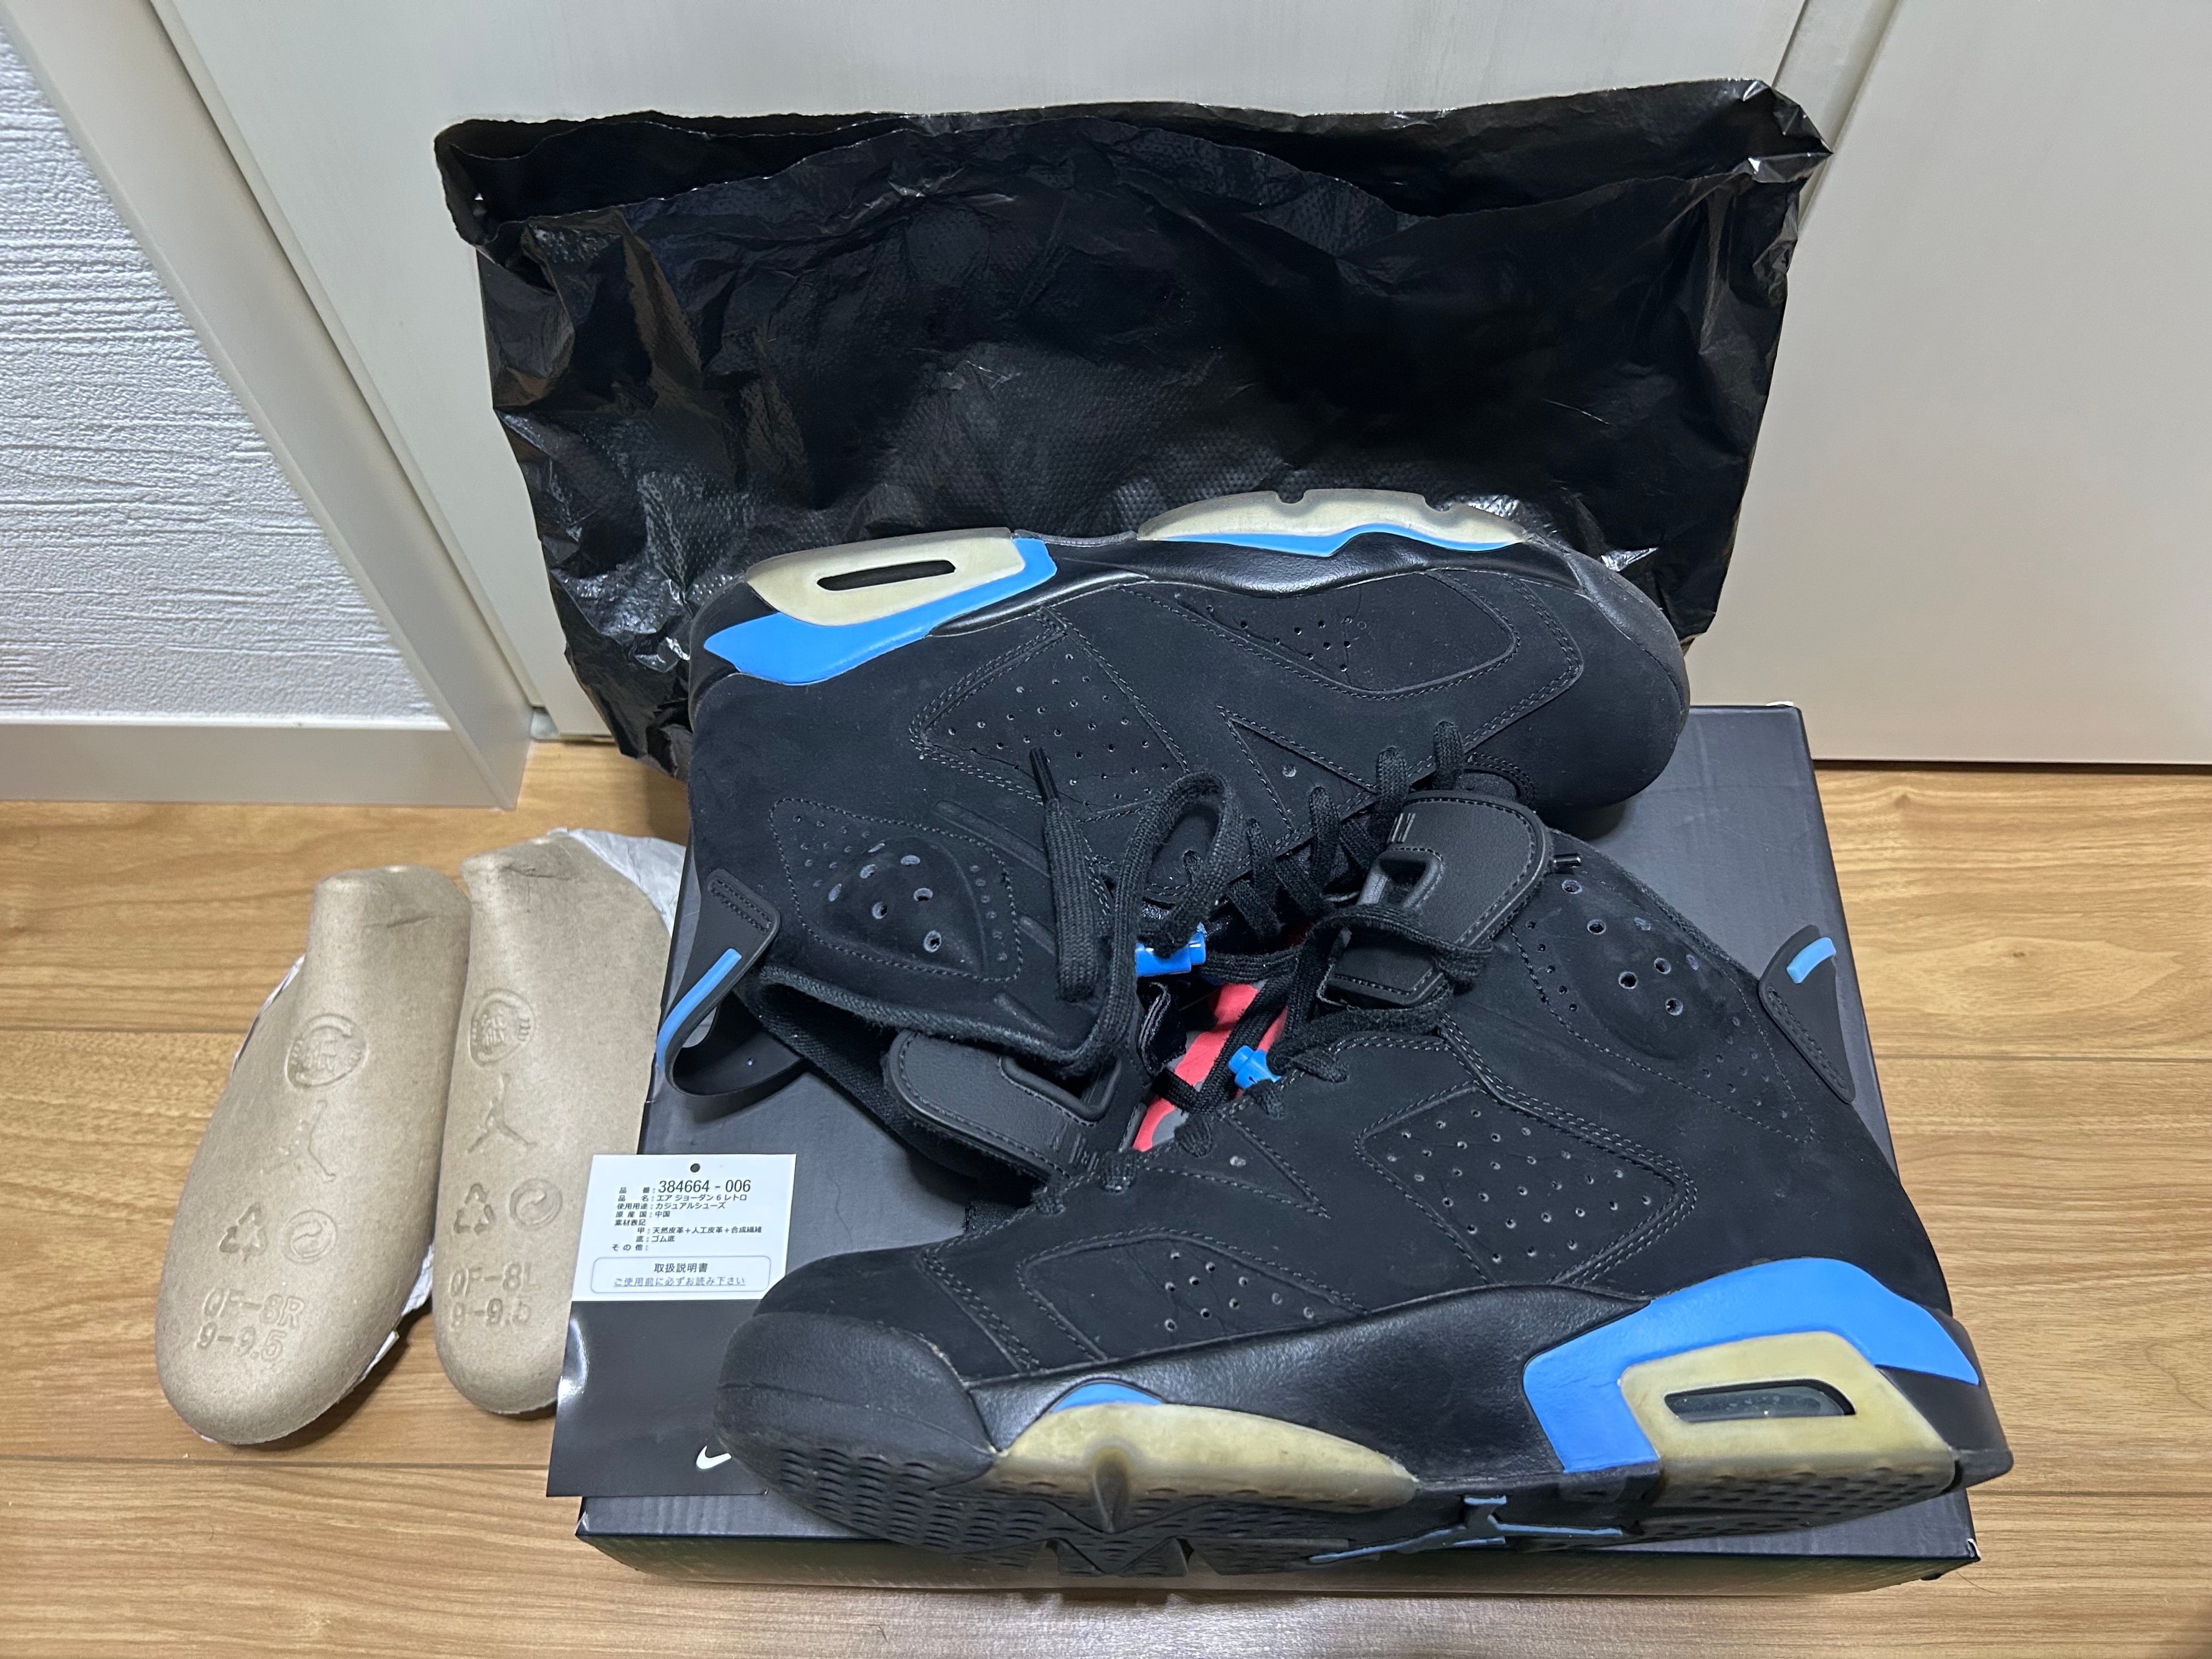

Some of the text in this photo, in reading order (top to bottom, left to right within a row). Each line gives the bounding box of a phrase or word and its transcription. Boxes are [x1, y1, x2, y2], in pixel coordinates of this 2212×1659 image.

[658, 1180, 710, 1193] 384664
[725, 1179, 752, 1193] 006
[654, 1262, 709, 1273] 取扱説明書
[614, 1276, 746, 1286] ご使用前に必ずお読み下さい
